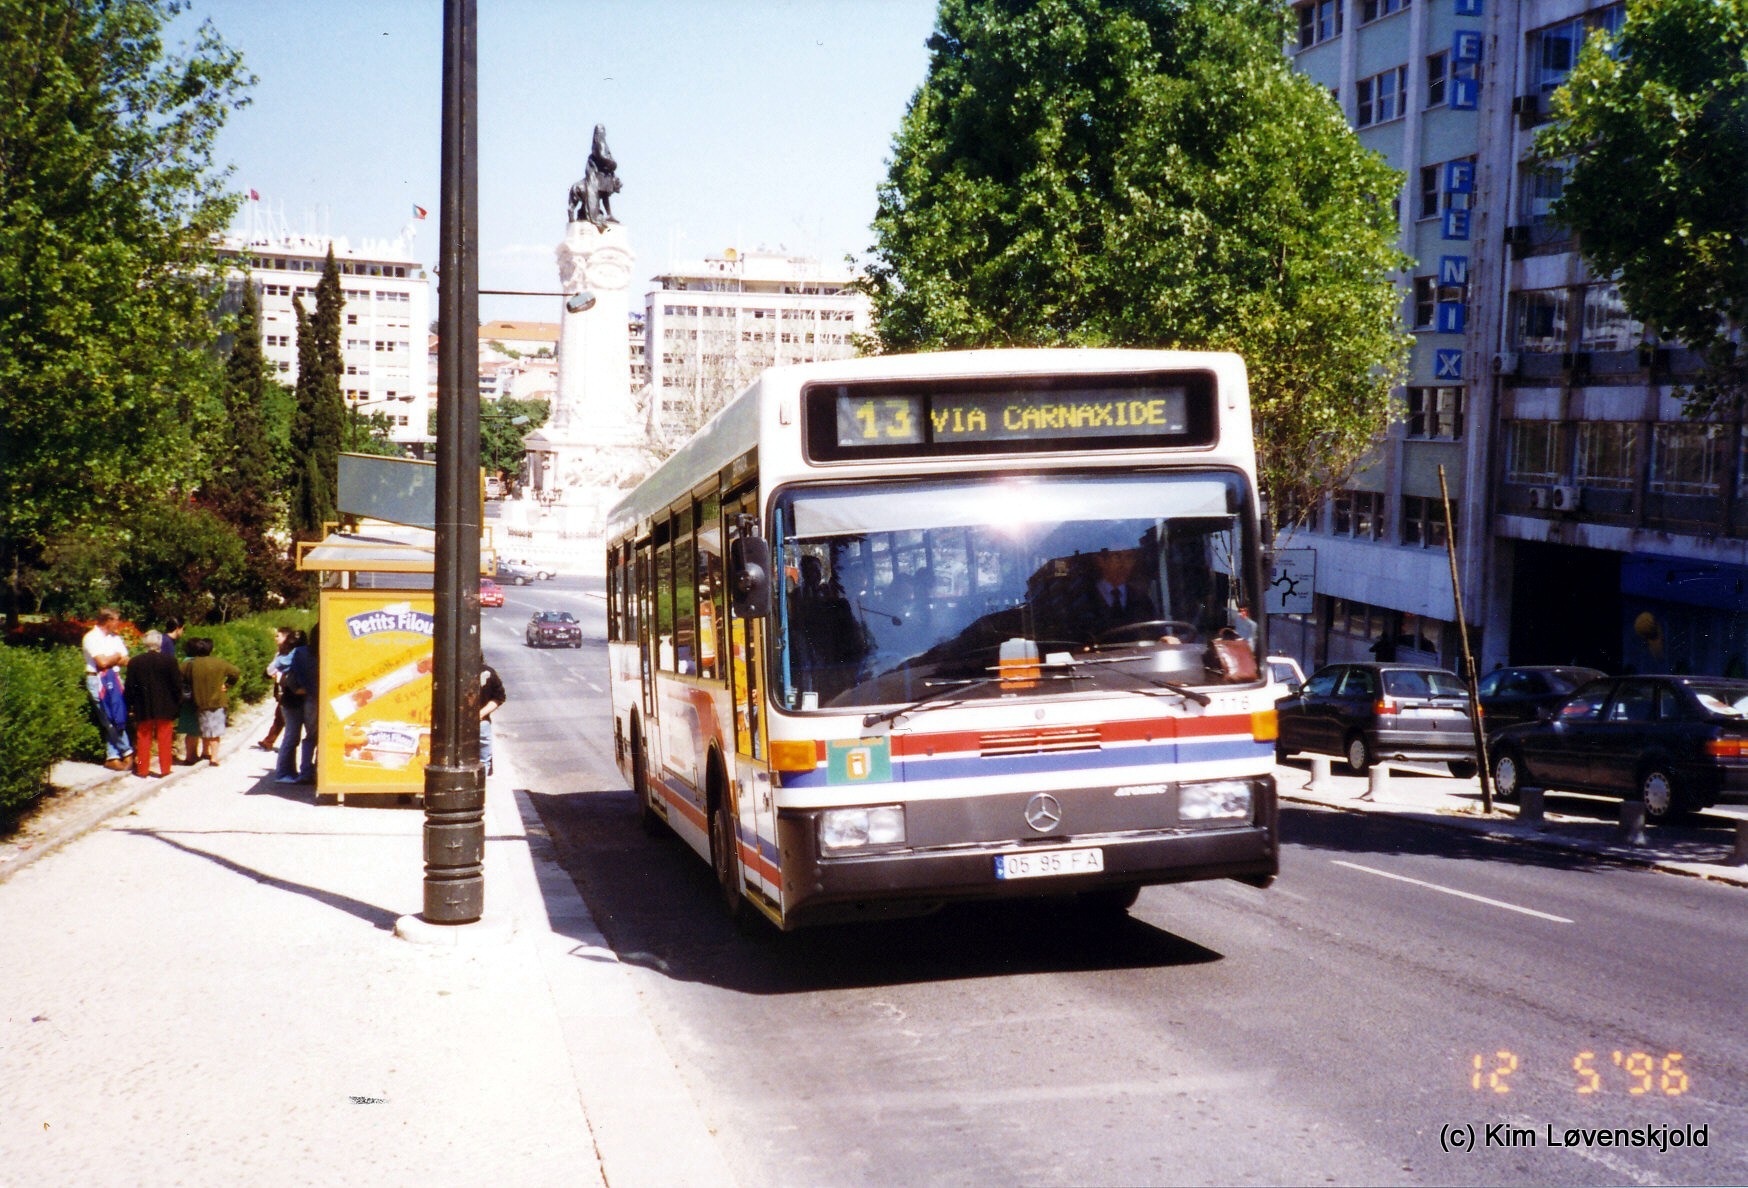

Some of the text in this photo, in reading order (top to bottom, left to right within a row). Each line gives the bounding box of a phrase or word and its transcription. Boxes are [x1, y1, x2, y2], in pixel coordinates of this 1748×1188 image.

[1438, 166, 1470, 377] FENIX
[856, 399, 1167, 438] 13 VIA CARNAXIDE
[349, 613, 434, 636] Petits Filou
[1008, 857, 1030, 874] 05
[1072, 852, 1099, 869] FA
